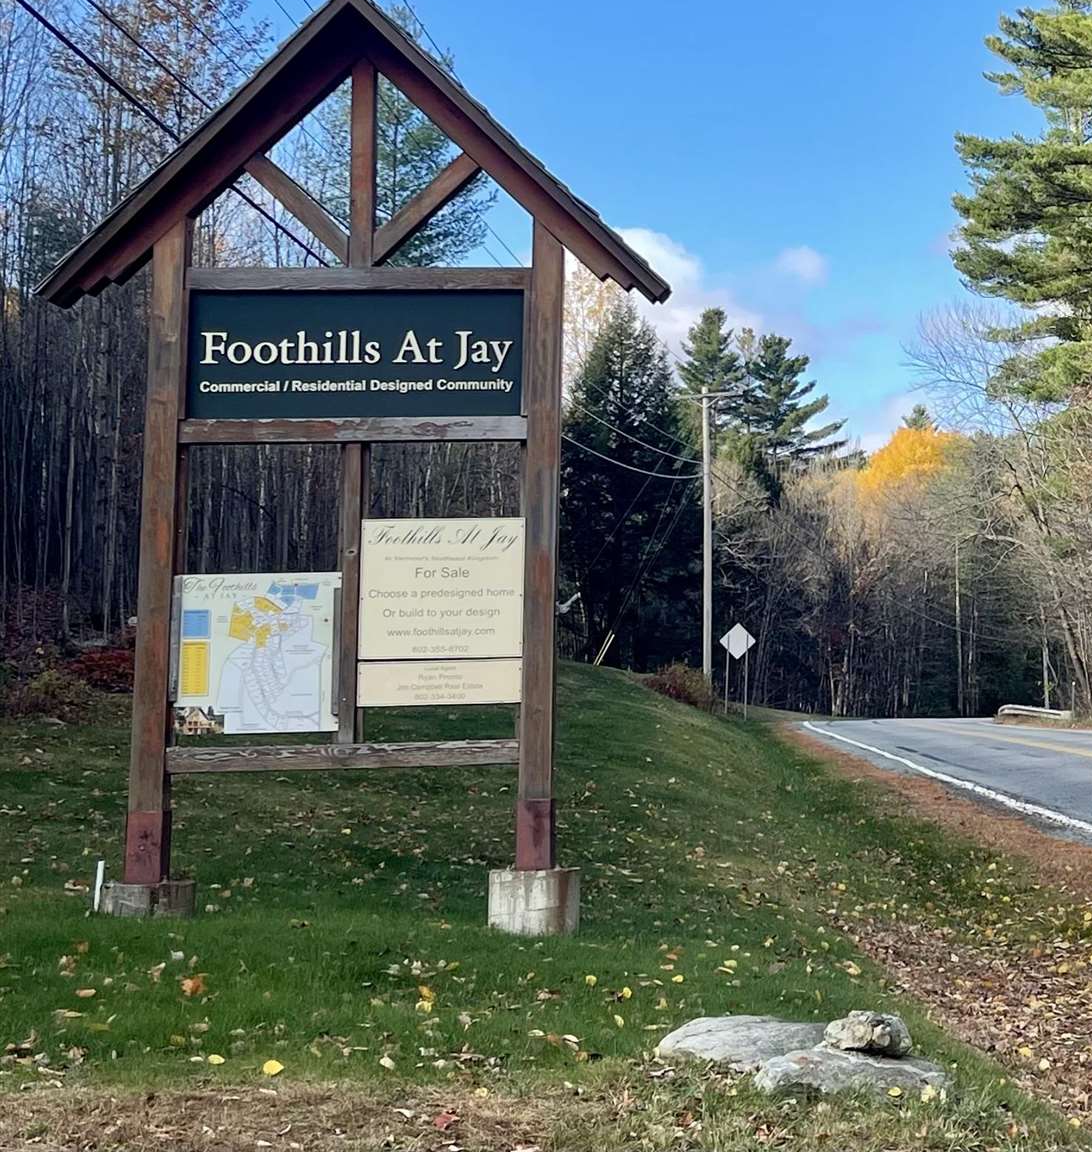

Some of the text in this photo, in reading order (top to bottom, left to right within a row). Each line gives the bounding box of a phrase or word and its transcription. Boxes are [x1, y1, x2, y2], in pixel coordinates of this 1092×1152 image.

[200, 330, 513, 372] Foothills At Jay
[200, 381, 280, 393] Commercial
[292, 380, 366, 392] Residential
[370, 380, 433, 393] Designed
[436, 379, 513, 393] Community
[368, 524, 519, 552] Foothills At Jay
[415, 566, 470, 578] For Sale
[368, 589, 408, 599] Choose
[420, 588, 483, 600] predesigned
[486, 588, 515, 597] home
[382, 608, 500, 619] Or build to your design
[386, 627, 496, 638] www.foothillsatjay.com
